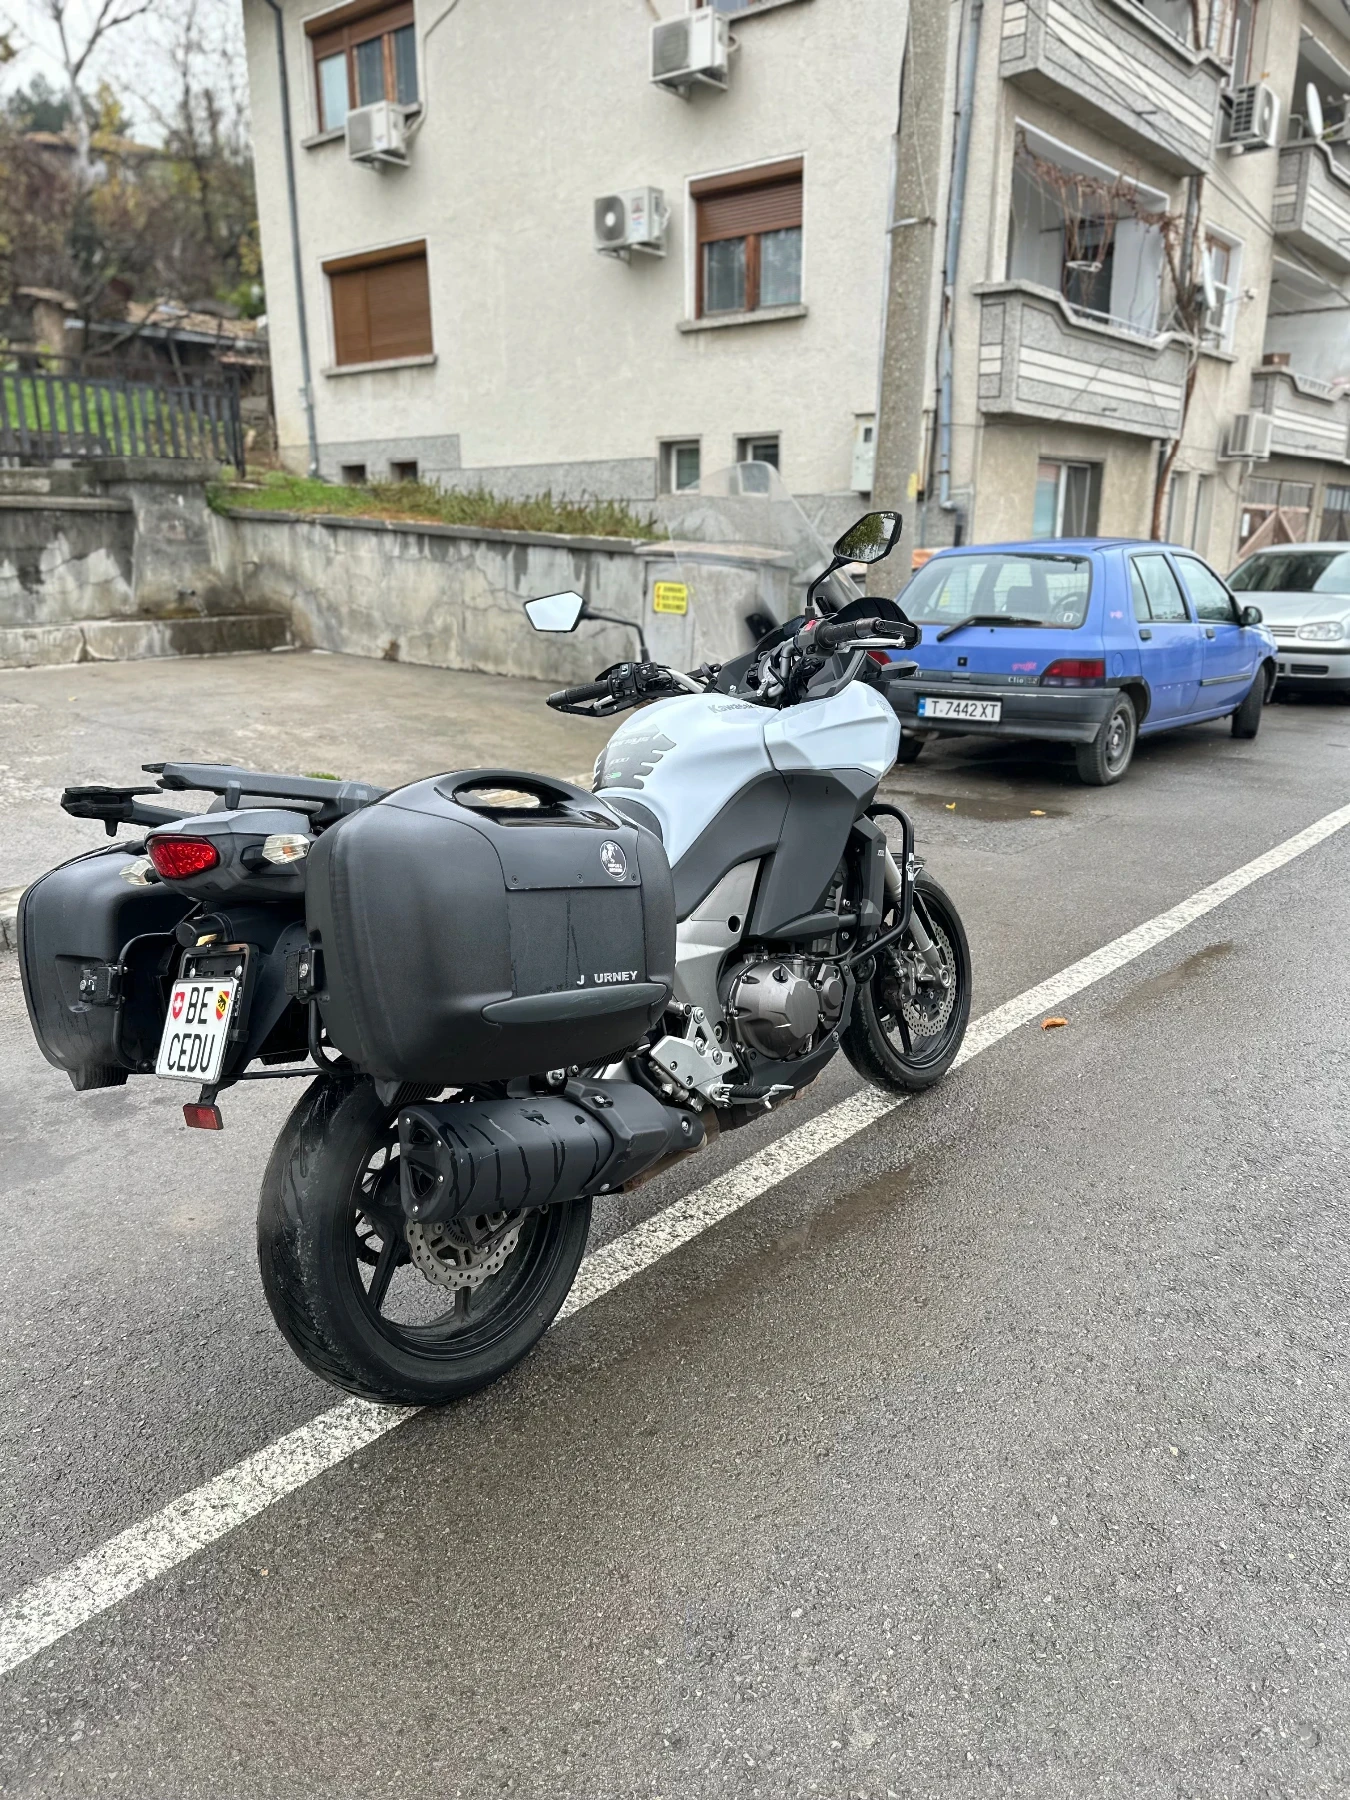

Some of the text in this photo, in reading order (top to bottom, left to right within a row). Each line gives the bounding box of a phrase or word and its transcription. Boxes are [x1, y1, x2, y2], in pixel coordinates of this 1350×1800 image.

[1008, 676, 1024, 684] Clio
[185, 986, 214, 1024] BE
[167, 1032, 216, 1073] CEDU
